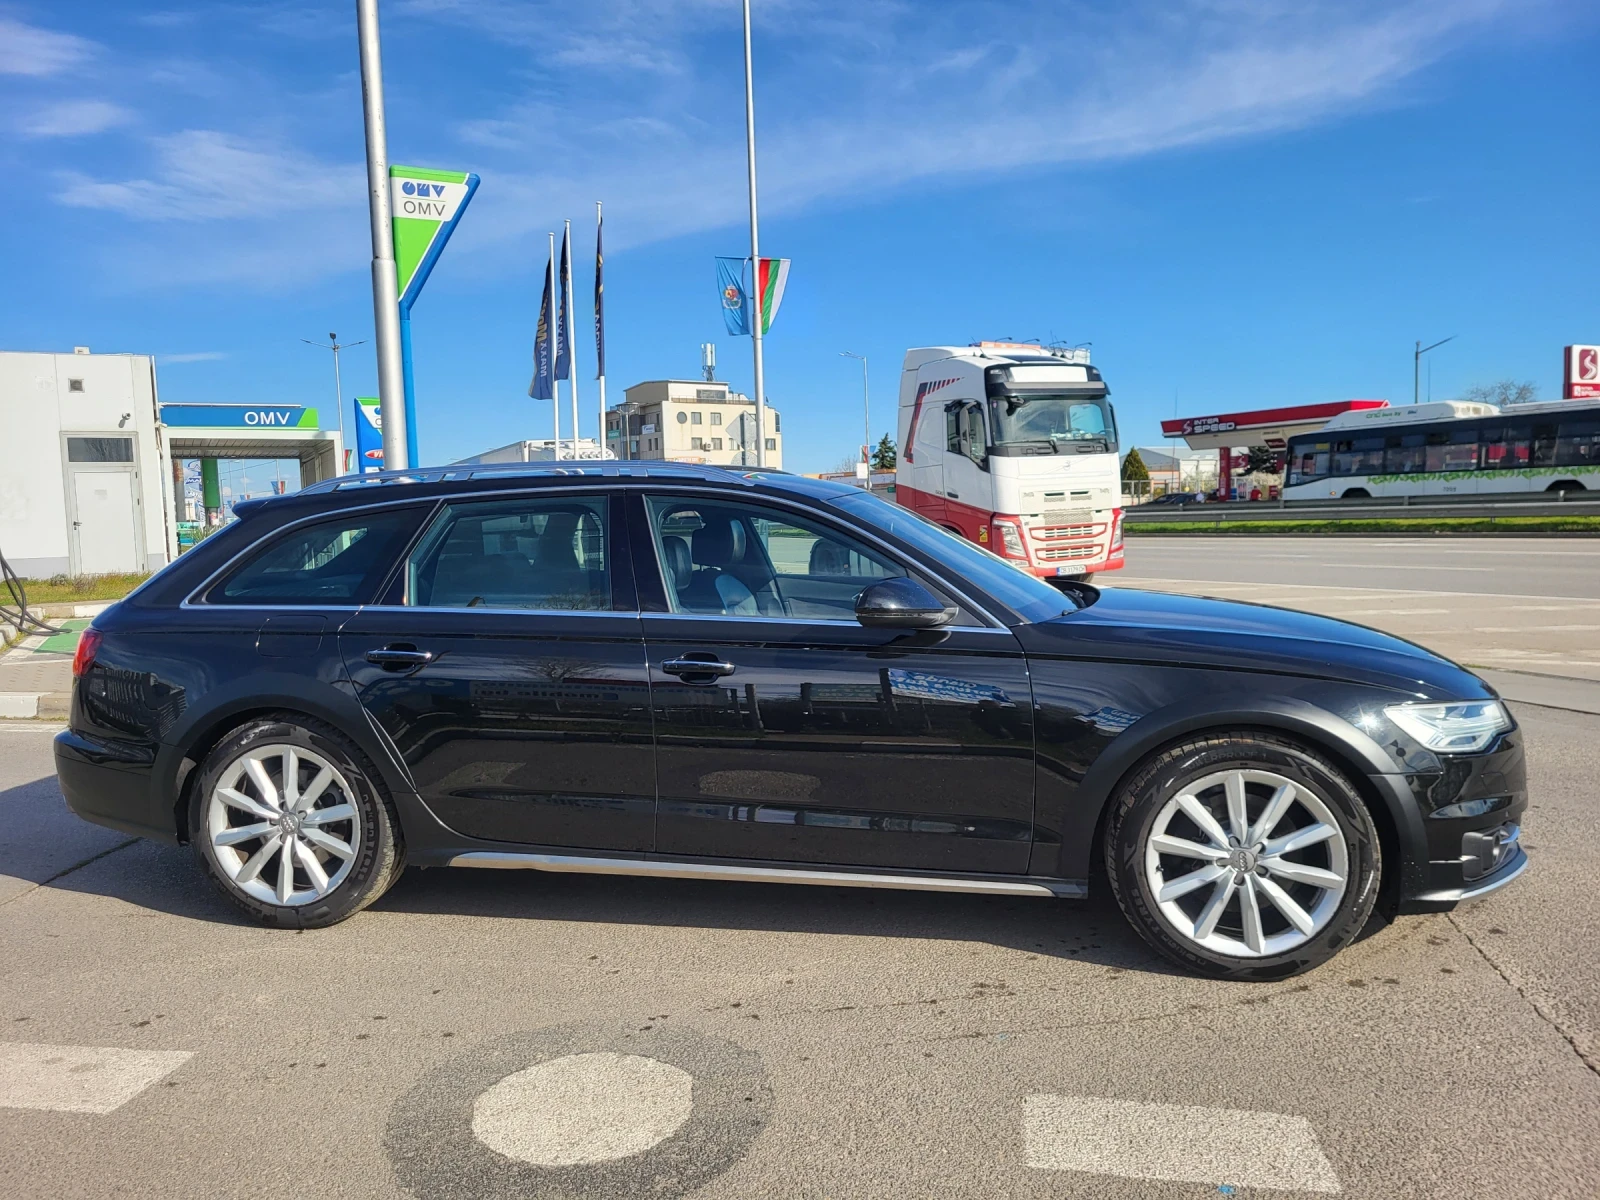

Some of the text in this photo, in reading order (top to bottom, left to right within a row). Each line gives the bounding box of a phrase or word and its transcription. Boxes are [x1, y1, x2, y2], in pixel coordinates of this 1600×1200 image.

[404, 200, 446, 216] OMV
[244, 411, 290, 425] OMV
[1194, 417, 1219, 425] INTER
[1194, 422, 1235, 433] SPEED
